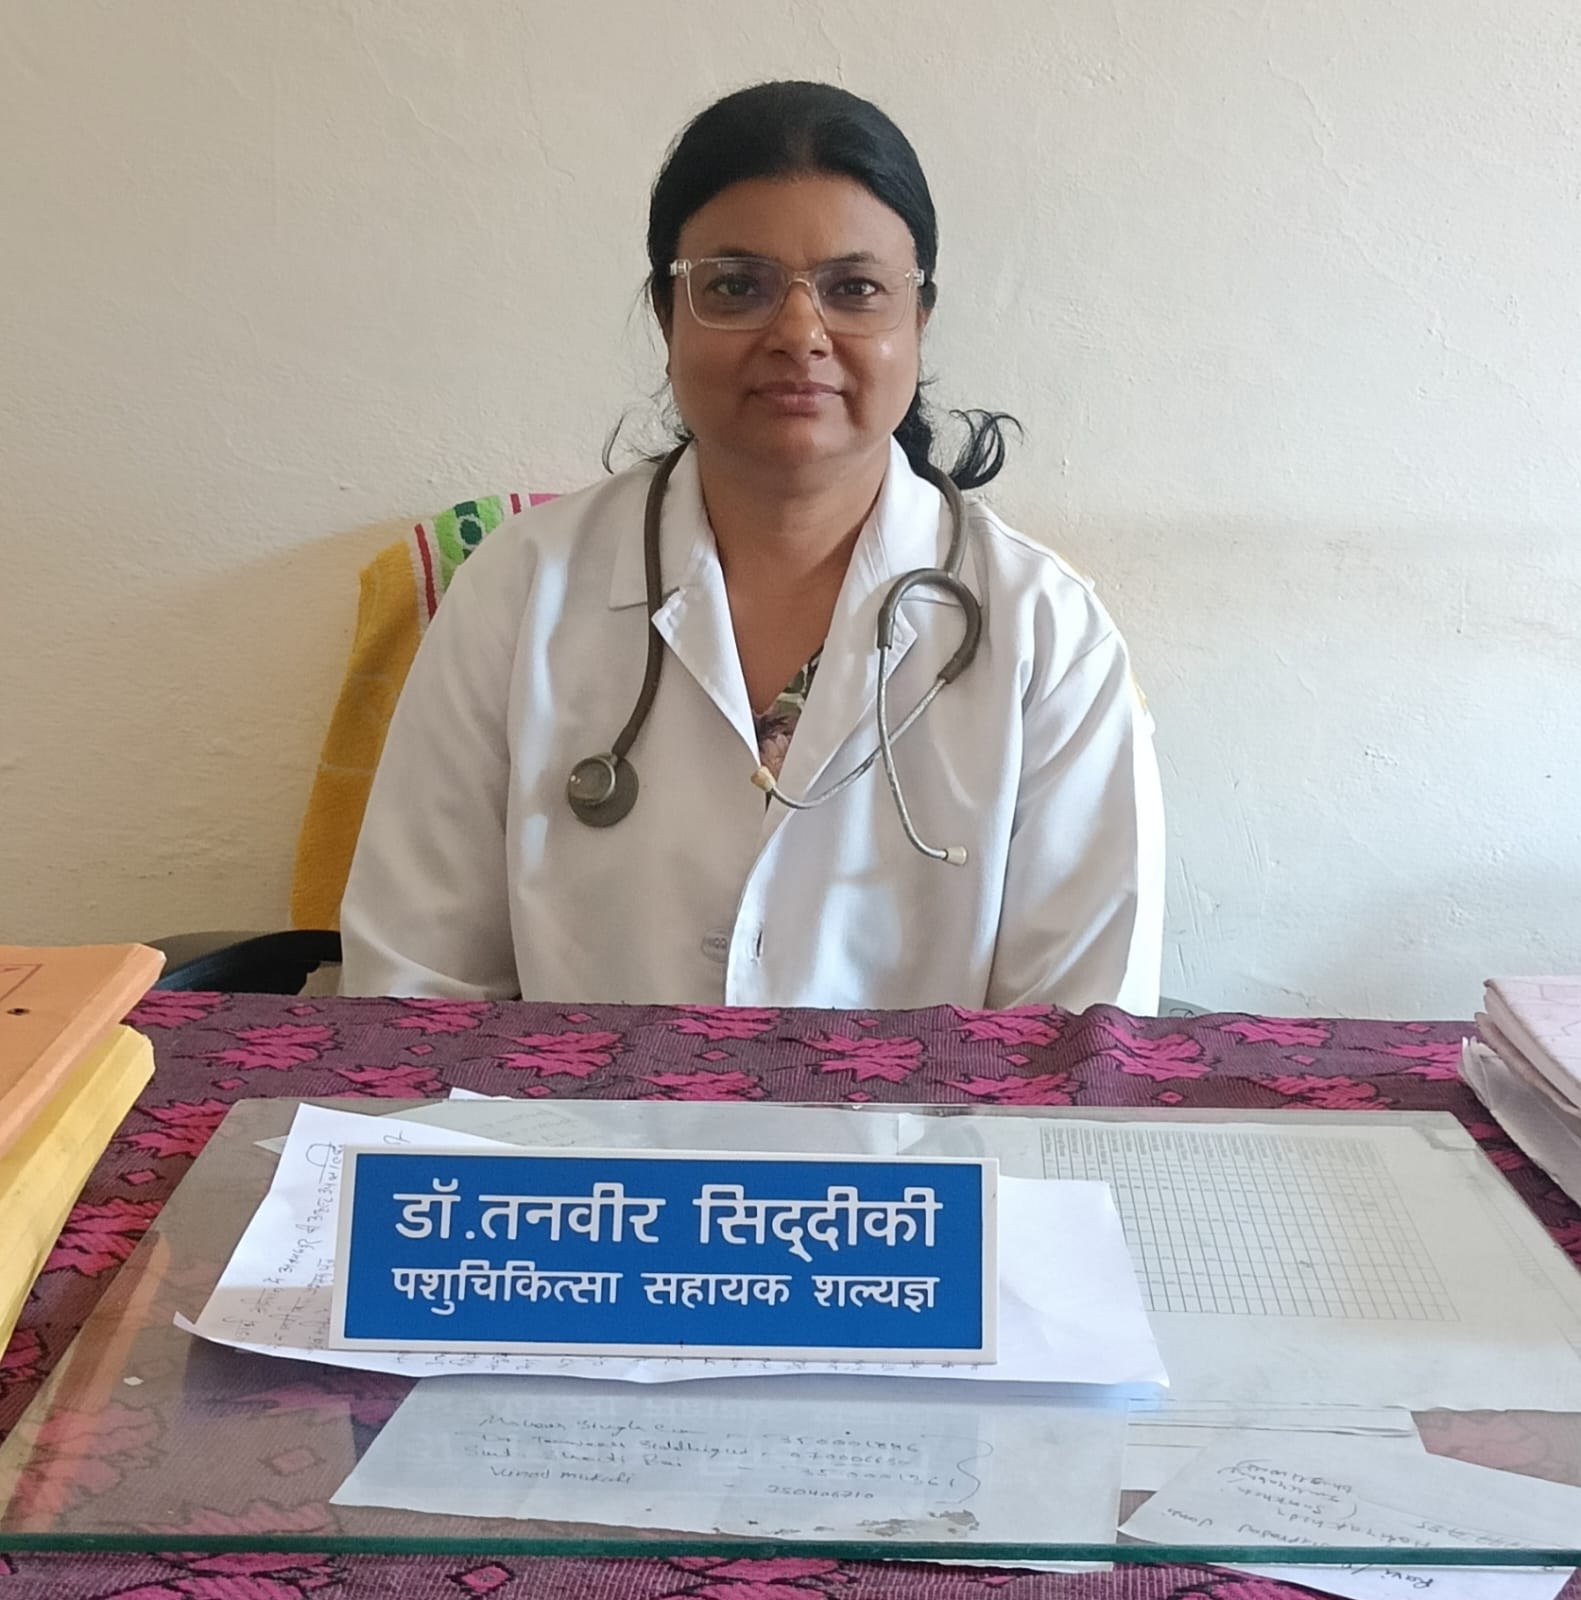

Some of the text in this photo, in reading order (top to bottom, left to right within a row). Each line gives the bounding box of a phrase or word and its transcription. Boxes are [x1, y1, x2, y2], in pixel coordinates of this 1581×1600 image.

[391, 1259, 939, 1315] पशुचिकित्सा सहायक शल्यज्ञ
